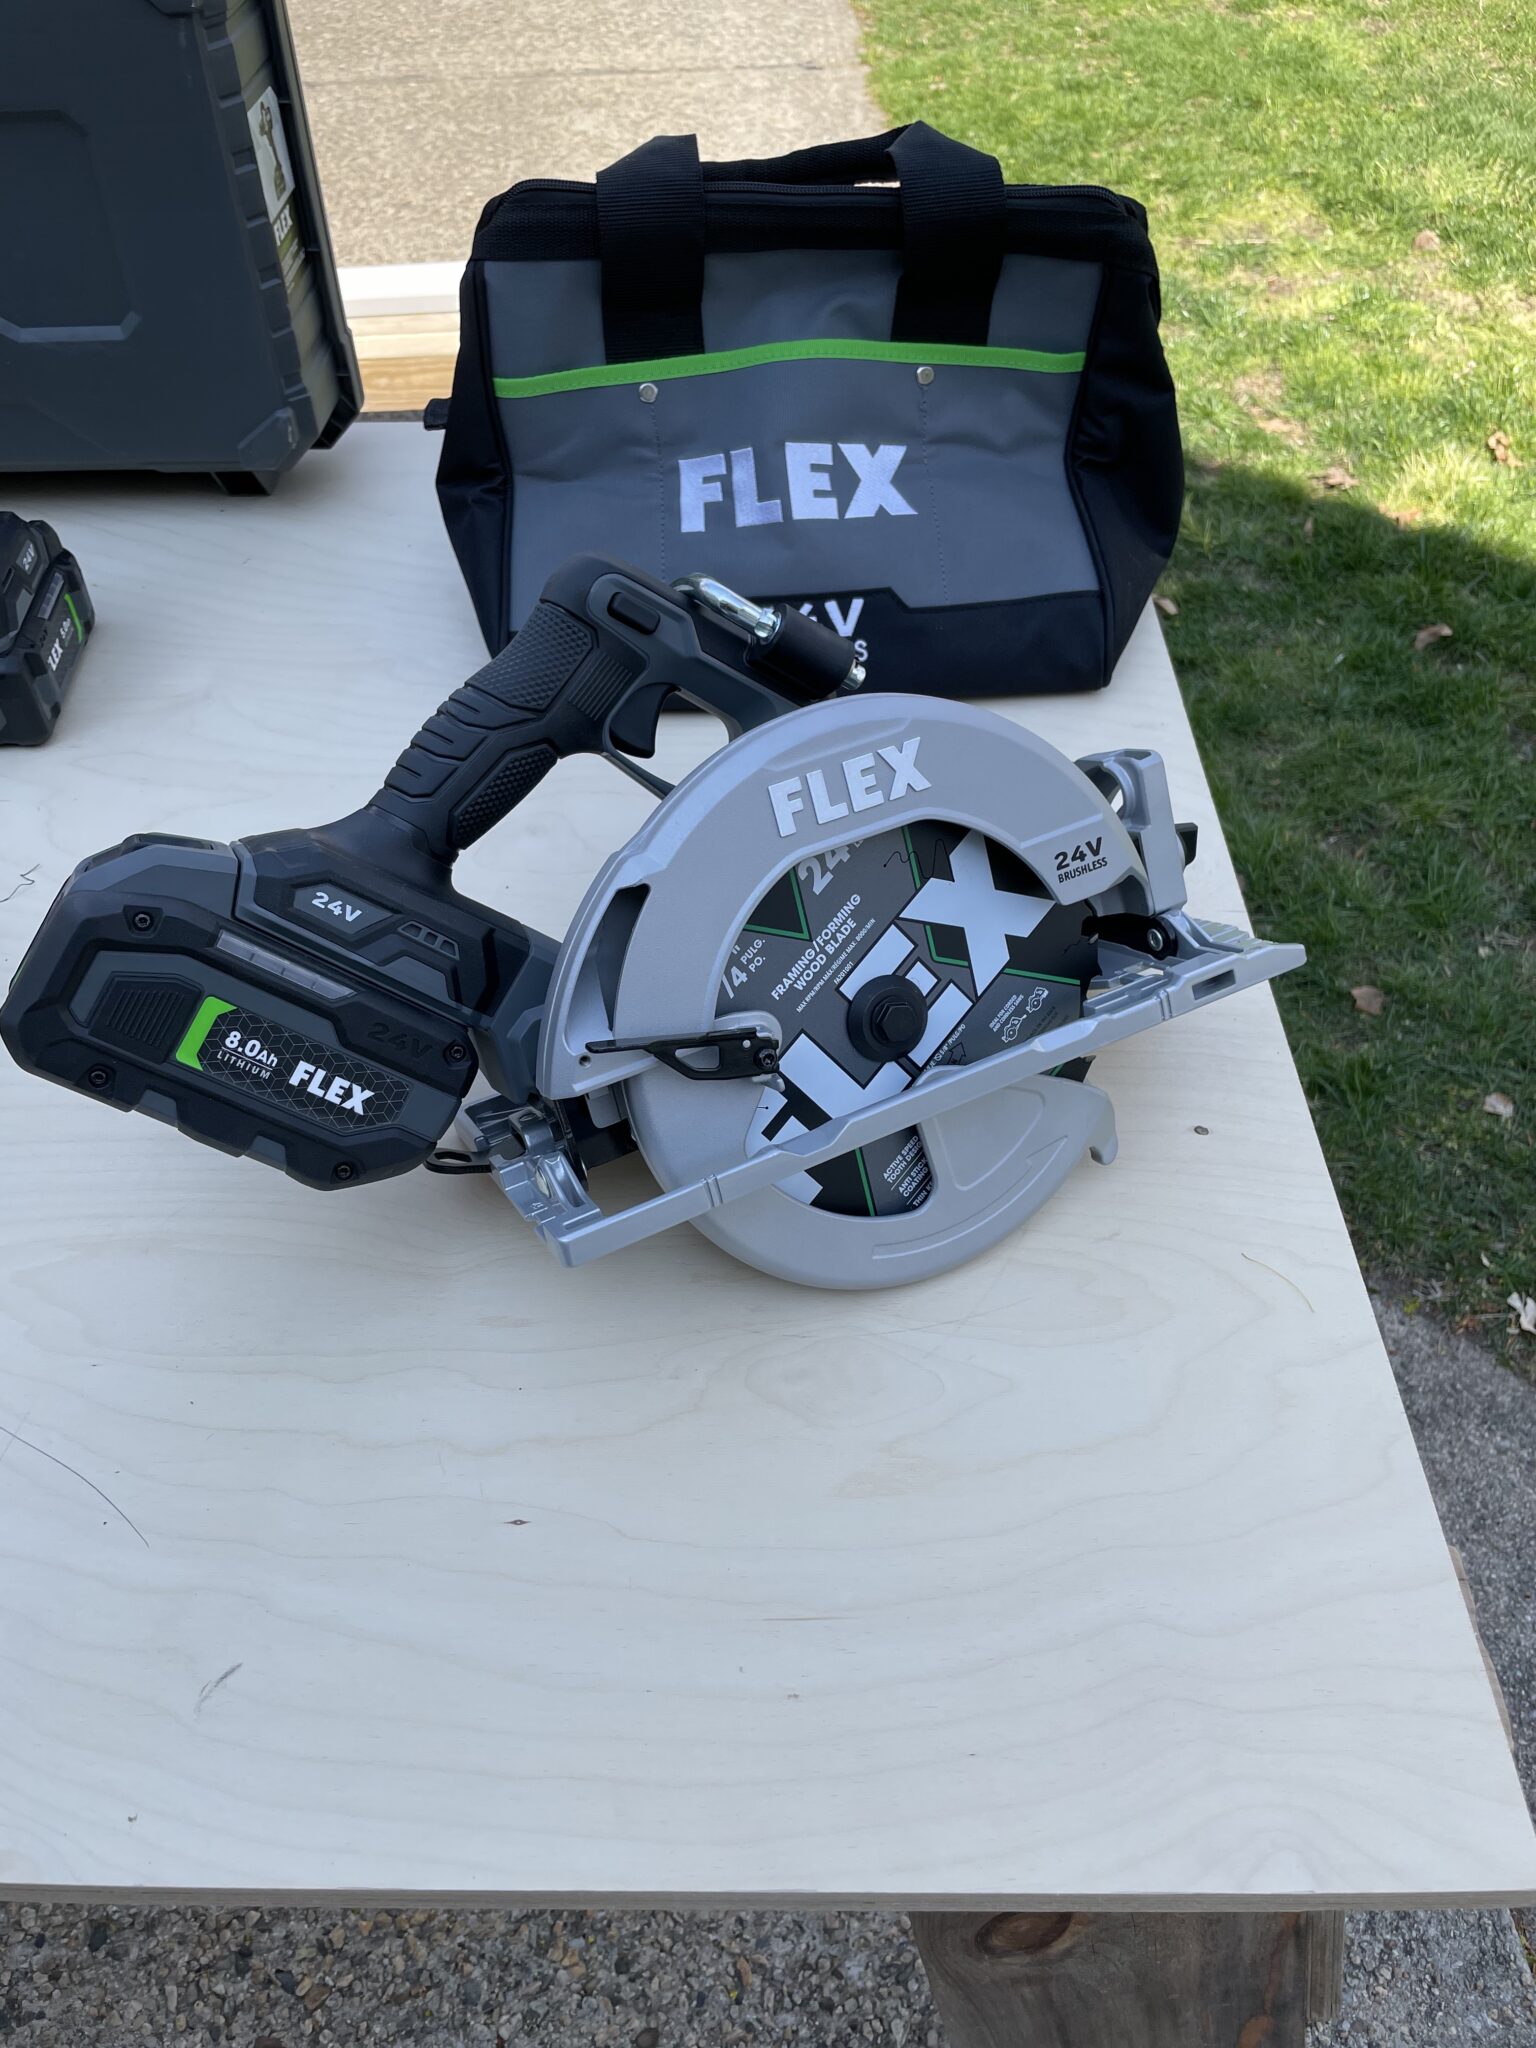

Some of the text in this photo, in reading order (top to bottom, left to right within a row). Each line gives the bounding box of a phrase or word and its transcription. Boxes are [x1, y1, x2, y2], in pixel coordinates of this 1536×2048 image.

[678, 442, 919, 533] FLEX
[768, 736, 932, 838] FLEX
[1054, 837, 1103, 871] 24V
[1057, 857, 1108, 884] BRUSHLESS
[311, 891, 362, 922] 24V
[740, 939, 766, 965] PULG.
[771, 893, 861, 1000] FRAMING/FORMING
[793, 918, 857, 990] WOOD BLADE
[748, 956, 766, 973] PO.
[833, 961, 853, 984] FA201001
[796, 1000, 807, 1012] MAX
[804, 979, 824, 1002] RPM/RPM
[988, 994, 1017, 1028] IDEAL FOR CORDED
[992, 994, 1023, 1031] AND CORDLESS SAWS
[224, 1031, 278, 1068] 8.0Ah
[368, 1022, 432, 1059] 24V
[217, 1050, 270, 1080] LITHIUM
[288, 1060, 375, 1116] FLEX
[883, 1135, 918, 1179] ACTIVE SPEED
[886, 1161, 907, 1183] TOOTH
[898, 1176, 912, 1193] ANTI
[903, 1167, 928, 1197] COATING
[913, 1190, 928, 1207] THIN
